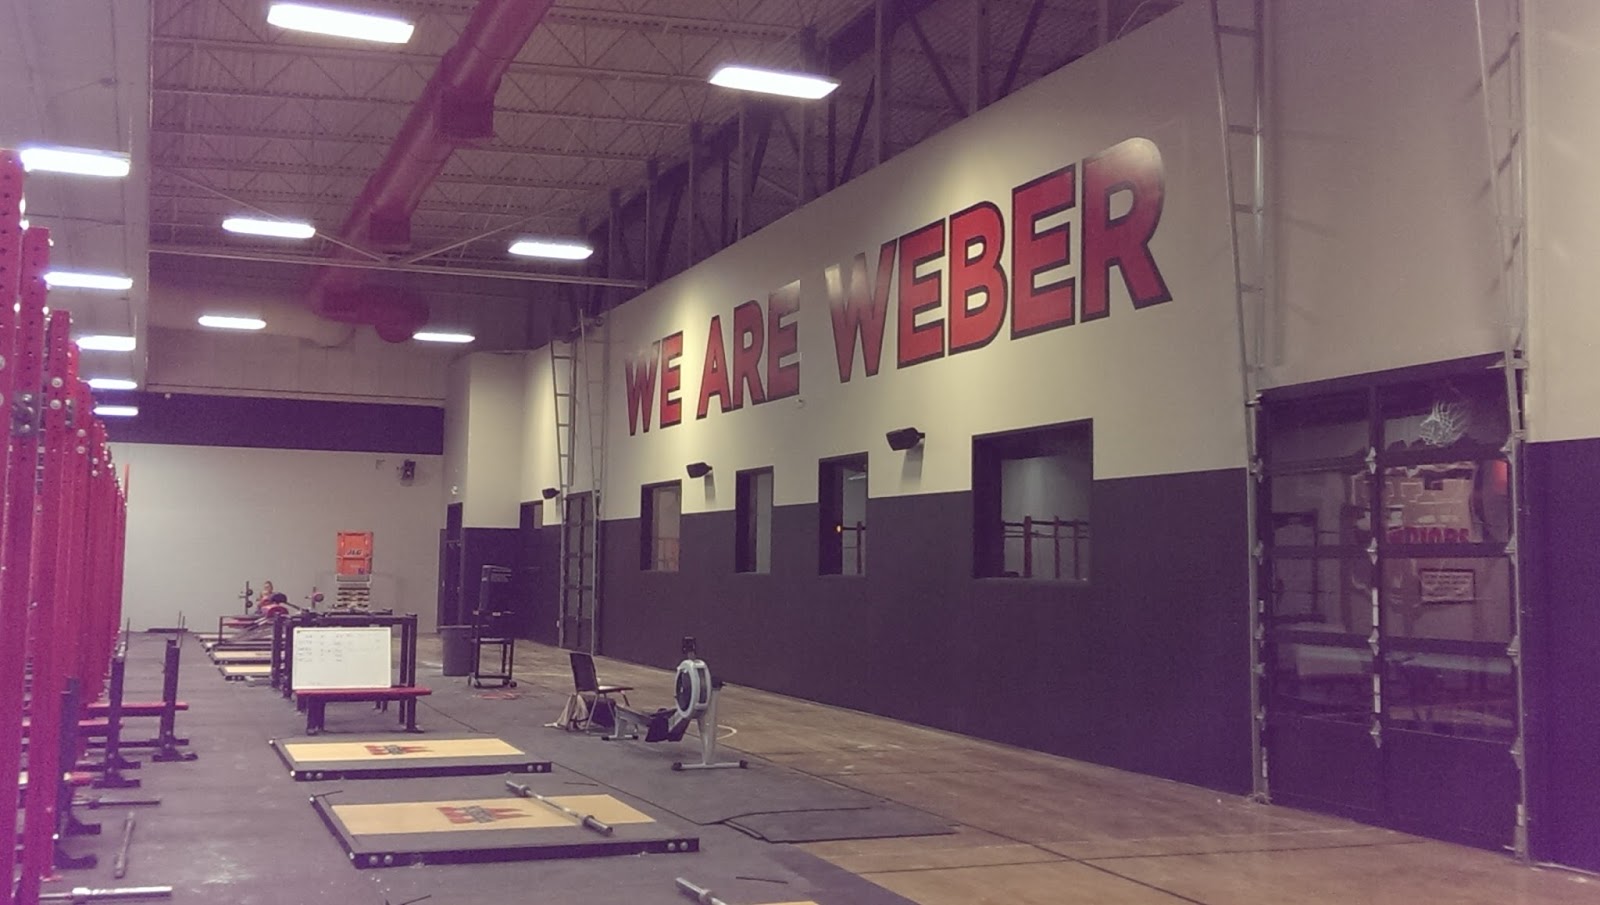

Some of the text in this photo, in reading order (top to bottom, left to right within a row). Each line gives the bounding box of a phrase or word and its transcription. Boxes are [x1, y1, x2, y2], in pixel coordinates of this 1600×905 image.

[624, 137, 1173, 436] WE ARE WEBER
